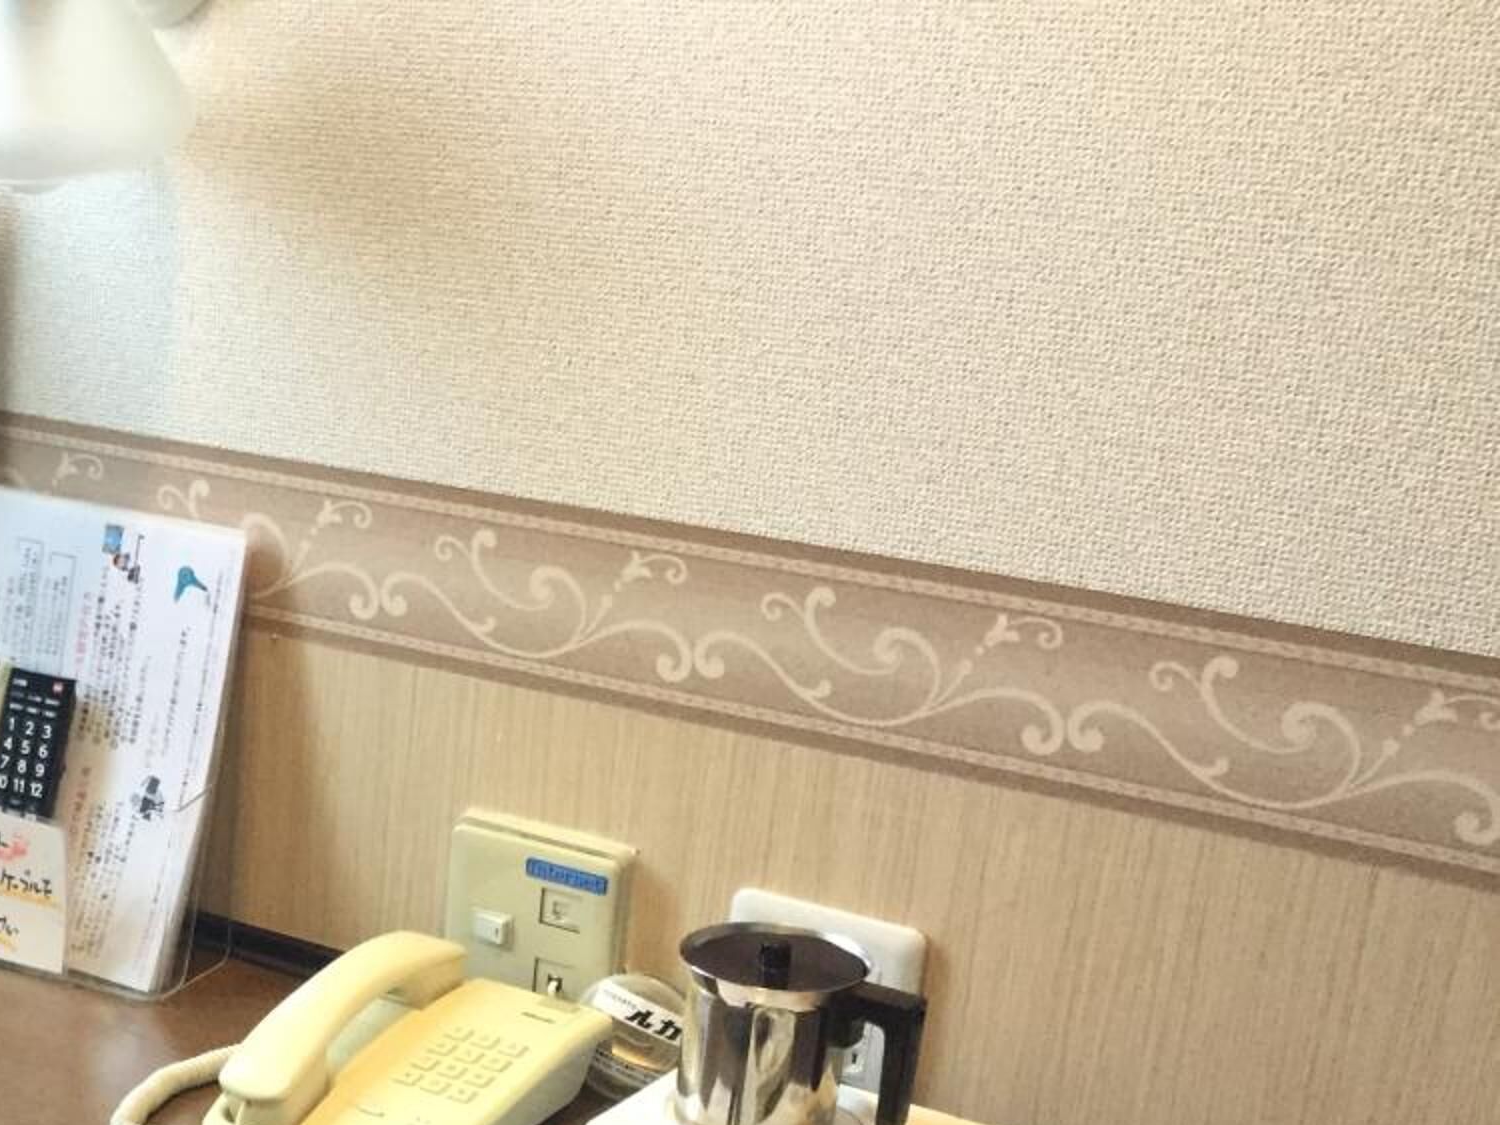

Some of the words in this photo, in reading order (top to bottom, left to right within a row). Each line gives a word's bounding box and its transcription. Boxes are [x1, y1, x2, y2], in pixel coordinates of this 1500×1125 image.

[8, 716, 16, 732] 1
[24, 720, 35, 736] 2
[41, 725, 52, 740] 3
[3, 736, 13, 751] 4
[20, 739, 31, 755] 5
[38, 744, 48, 759] 6
[0, 754, 10, 770] 7
[16, 758, 27, 774] 8
[35, 763, 45, 778] 9
[13, 777, 25, 794] 11
[30, 782, 43, 799] 12
